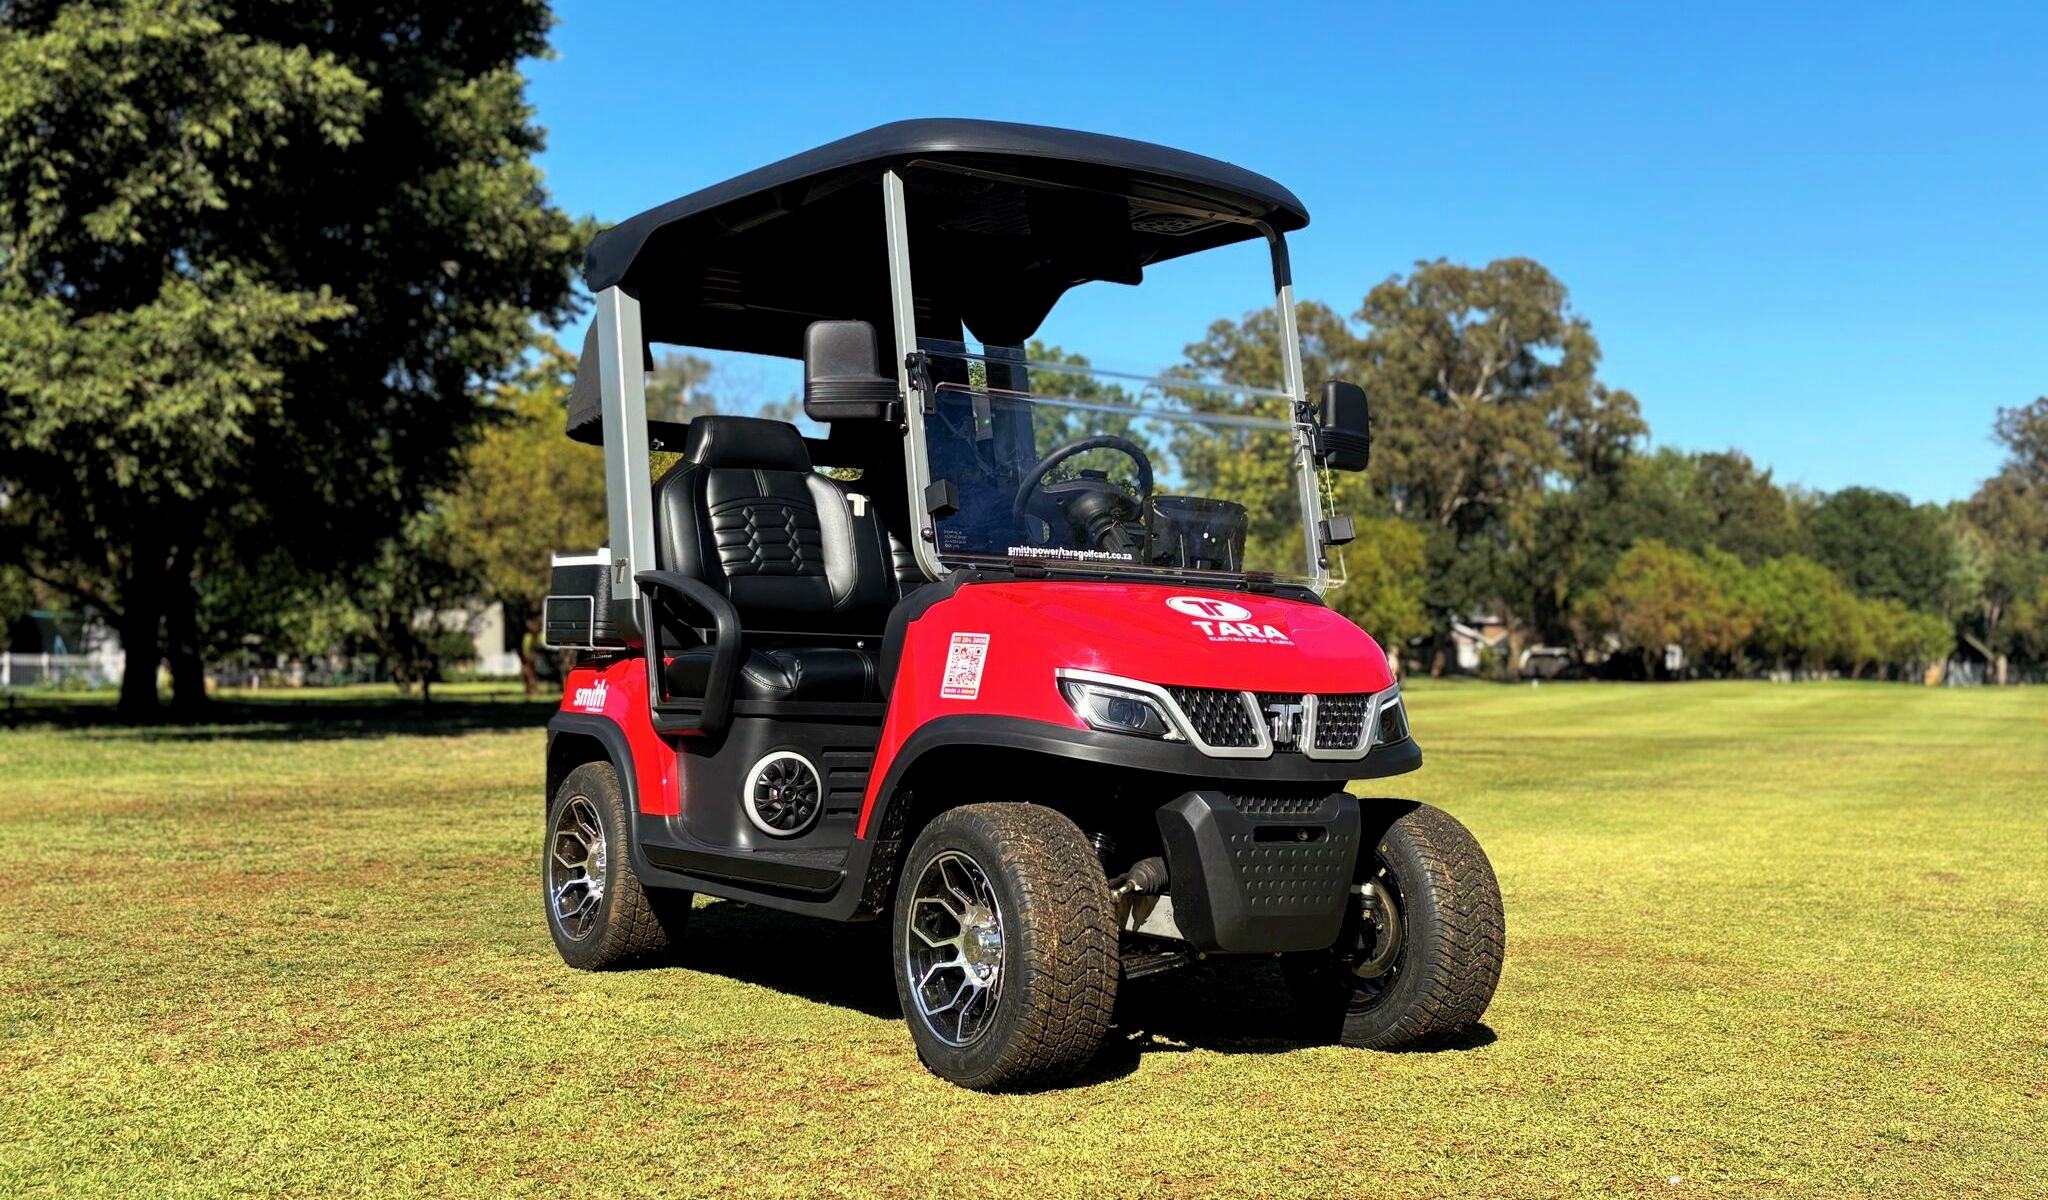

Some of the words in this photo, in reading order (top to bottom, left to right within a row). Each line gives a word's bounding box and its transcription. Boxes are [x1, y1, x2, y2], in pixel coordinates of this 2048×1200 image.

[1007, 545, 1133, 561] smithpower/taragolfcart.co.za
[1191, 621, 1290, 640] TARA
[573, 679, 607, 707] smith
